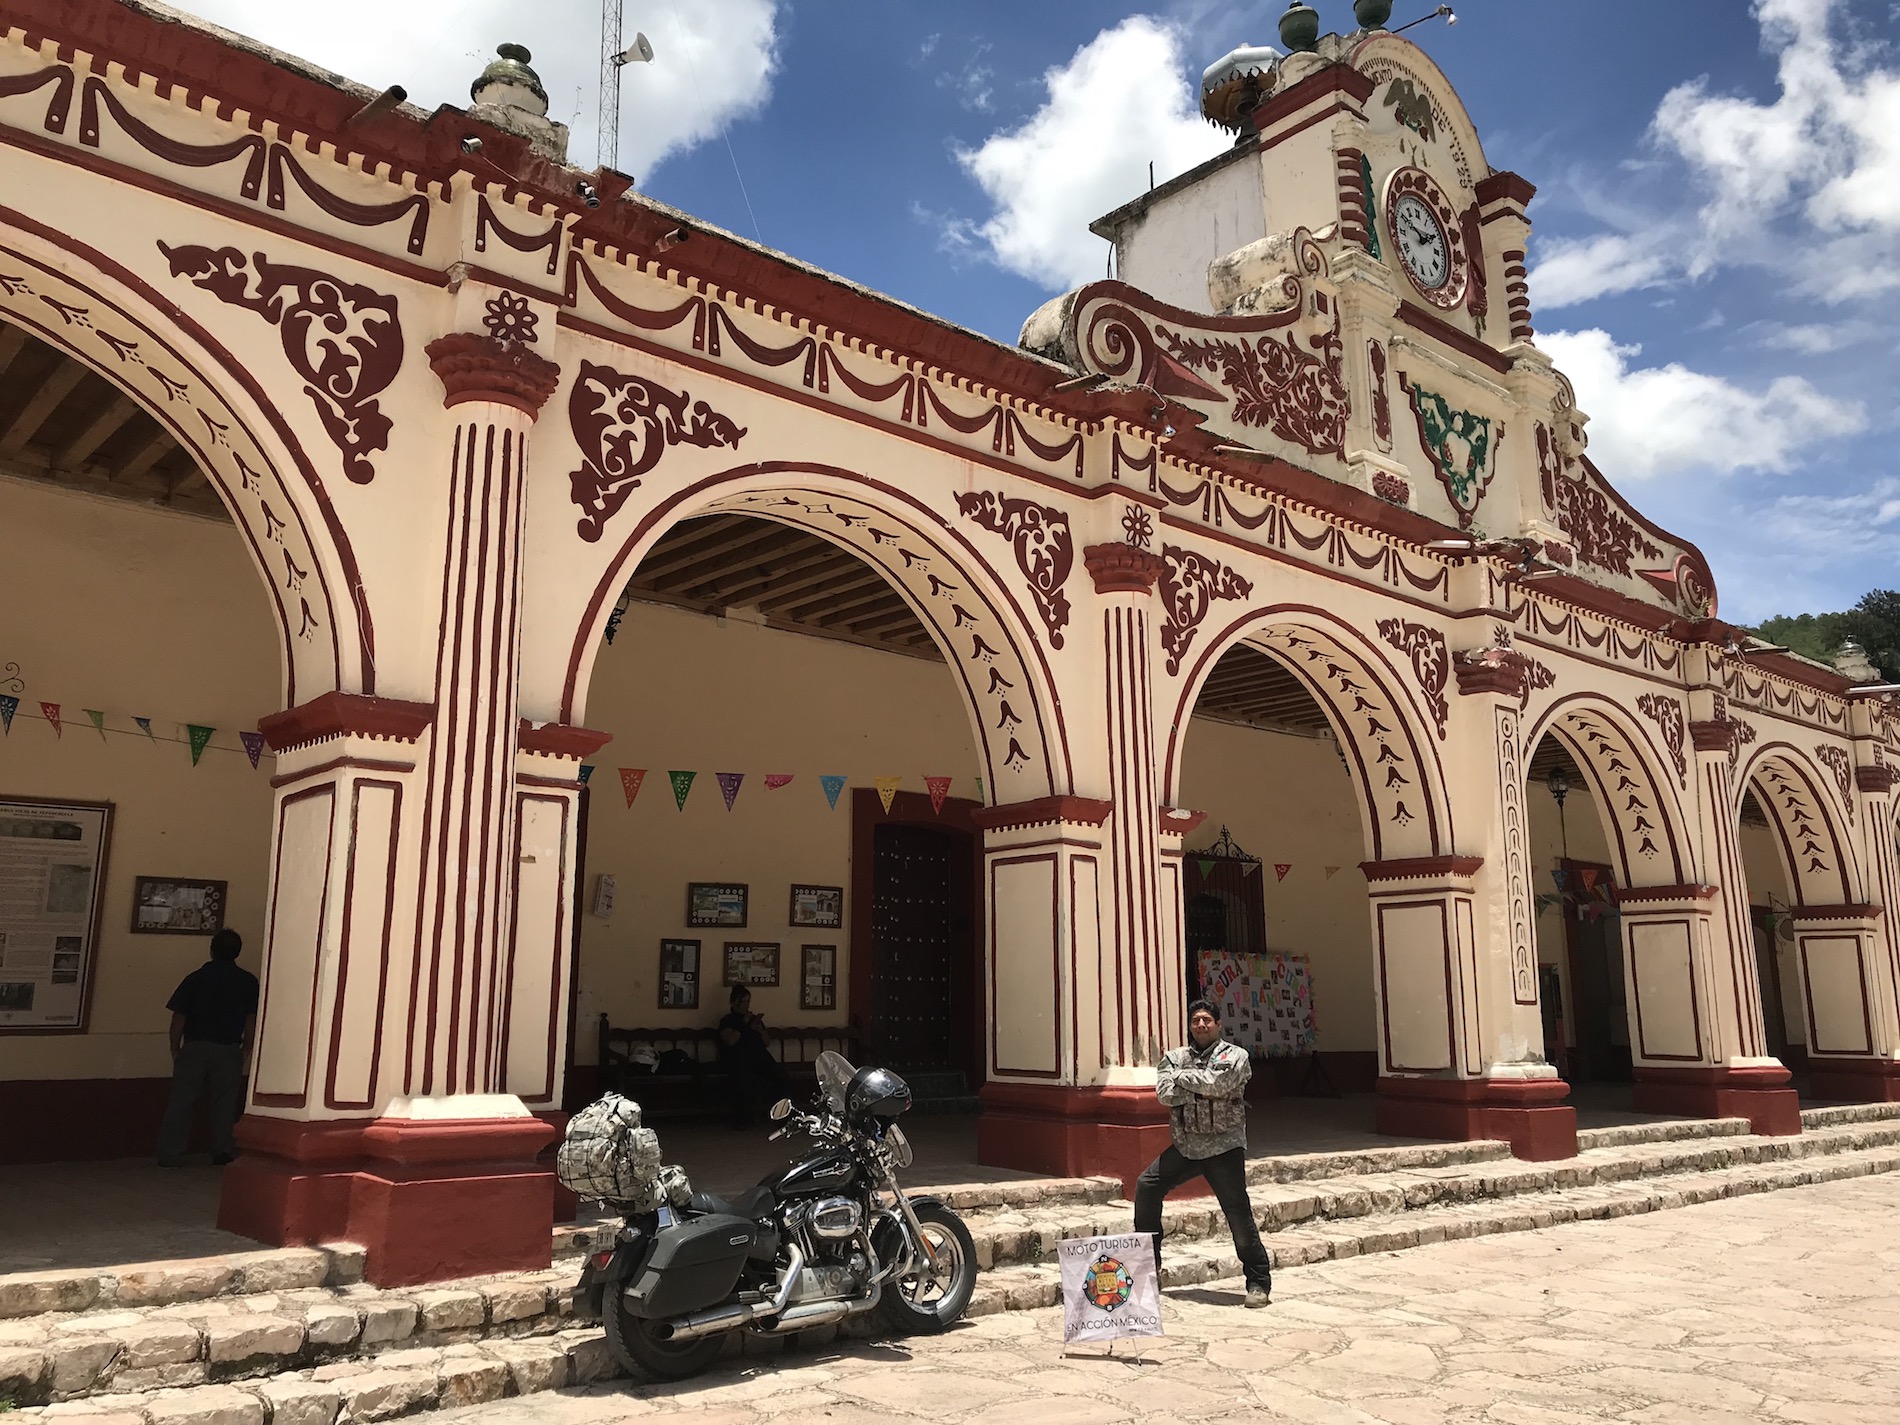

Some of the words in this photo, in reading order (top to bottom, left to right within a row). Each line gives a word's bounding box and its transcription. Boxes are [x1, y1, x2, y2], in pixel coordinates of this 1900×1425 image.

[1431, 108, 1446, 133] DE
[1232, 985, 1281, 1011] VERANO
[1067, 1242, 1098, 1256] MOTO
[1100, 1238, 1141, 1251] TURISTA
[1067, 1322, 1078, 1332] EN
[1080, 1316, 1118, 1331] ACCIÓN
[1119, 1314, 1158, 1327] MÉXICO
